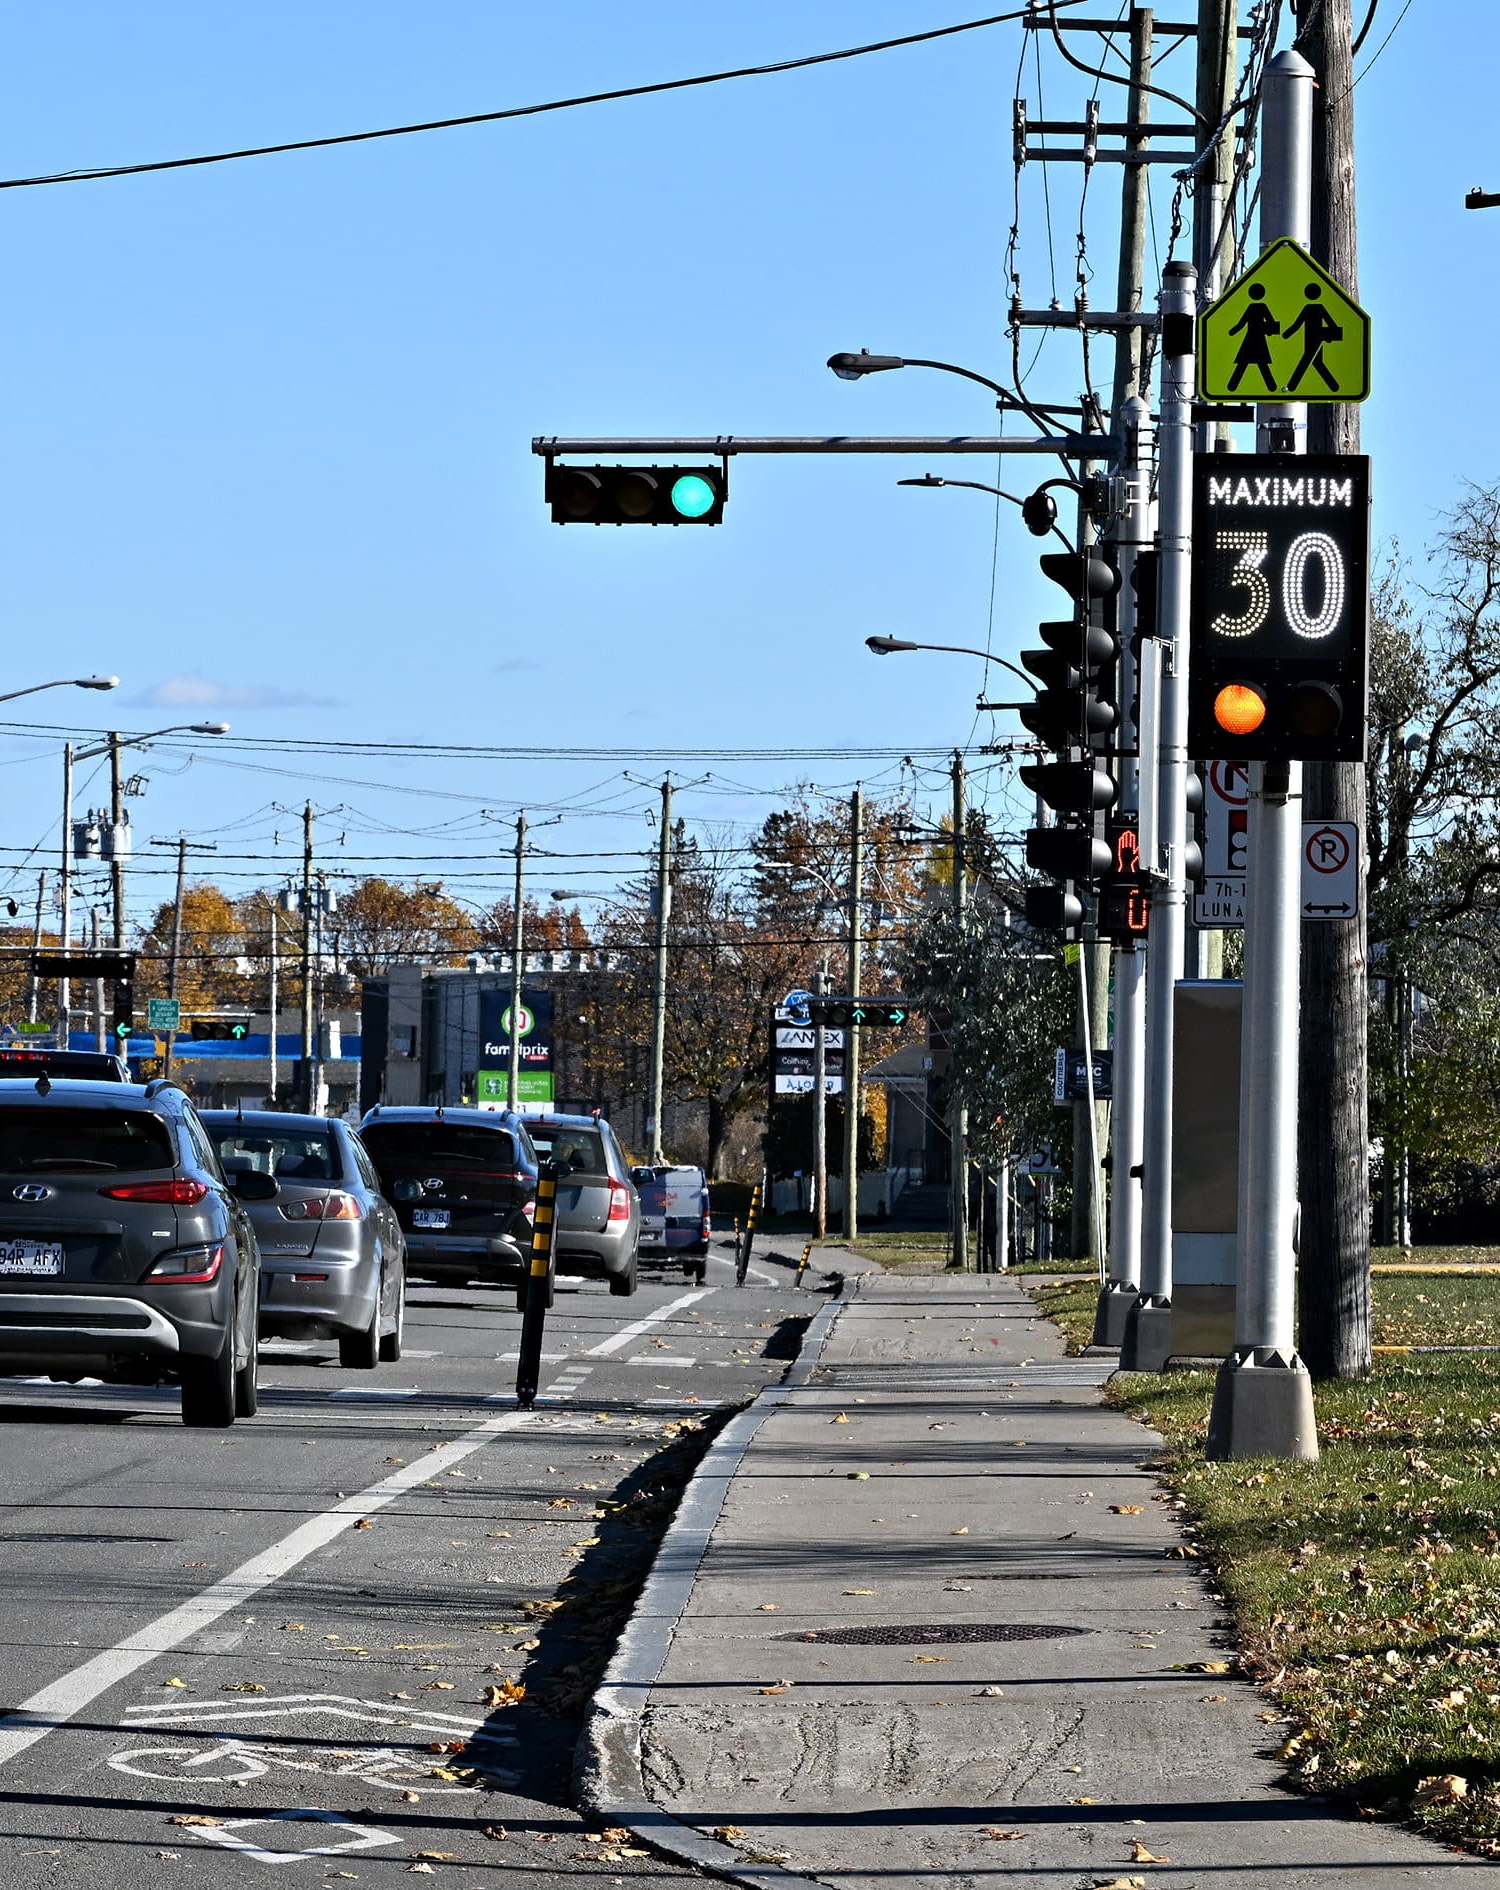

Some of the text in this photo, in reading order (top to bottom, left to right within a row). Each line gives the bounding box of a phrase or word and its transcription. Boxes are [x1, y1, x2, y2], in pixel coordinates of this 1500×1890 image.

[1209, 476, 1351, 507] MAXIMUM
[1210, 530, 1346, 639] 30
[1202, 902, 1231, 918] LUN
[33, 1248, 61, 1265] AFX
